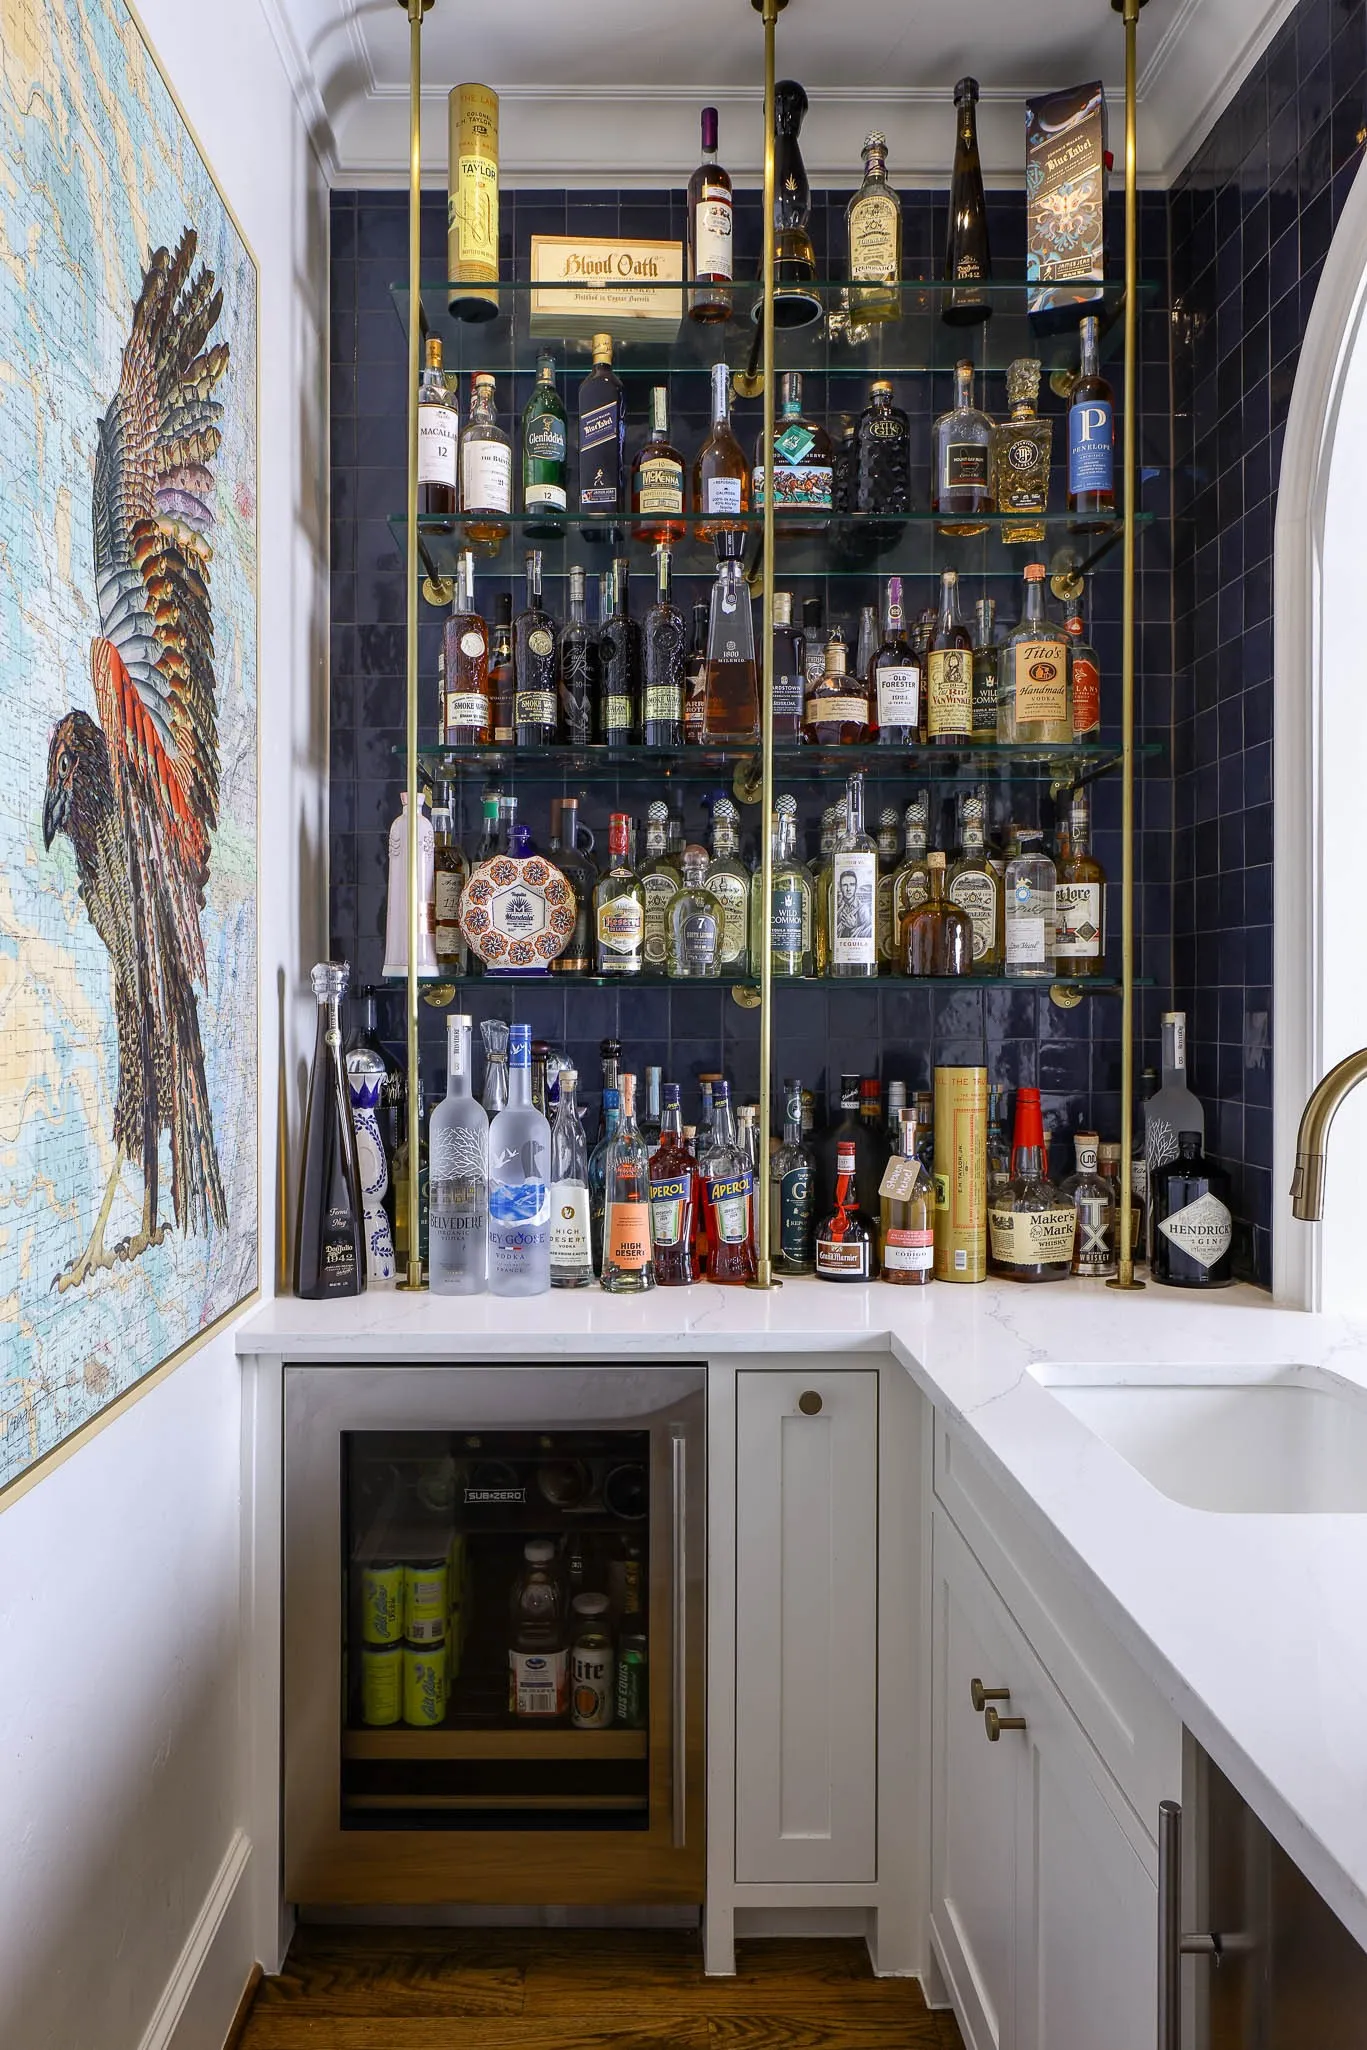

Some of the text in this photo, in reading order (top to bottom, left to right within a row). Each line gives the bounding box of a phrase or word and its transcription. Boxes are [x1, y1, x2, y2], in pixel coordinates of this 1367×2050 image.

[1045, 154, 1069, 173] Blue
[1065, 138, 1094, 160] Label
[462, 164, 496, 181] TAYLOR
[560, 253, 659, 277] Blood Oath
[1079, 408, 1107, 443] P
[529, 431, 564, 446] Glenfiddich
[438, 446, 448, 457] 12
[723, 650, 739, 658] 1800
[1024, 646, 1062, 660] Tito's
[881, 681, 916, 689] FORESTER
[1020, 685, 1065, 696] Handmade
[521, 700, 541, 708] SMOKE
[778, 909, 797, 917] WILD
[697, 917, 705, 929] 7
[951, 1078, 969, 1086] THE
[711, 1178, 751, 1200] APEROL
[791, 1182, 808, 1200] G
[431, 1213, 483, 1229] BELVEDERE
[1030, 1212, 1075, 1225] Maker's
[1043, 1225, 1074, 1237] Mark
[489, 1231, 545, 1245] REY GOOSE
[1038, 1238, 1068, 1247] WHISKY
[326, 1253, 355, 1263] 1942
[495, 1252, 526, 1260] VODKA
[615, 1249, 645, 1257] DESERT
[616, 1662, 630, 1695] EQUIS
